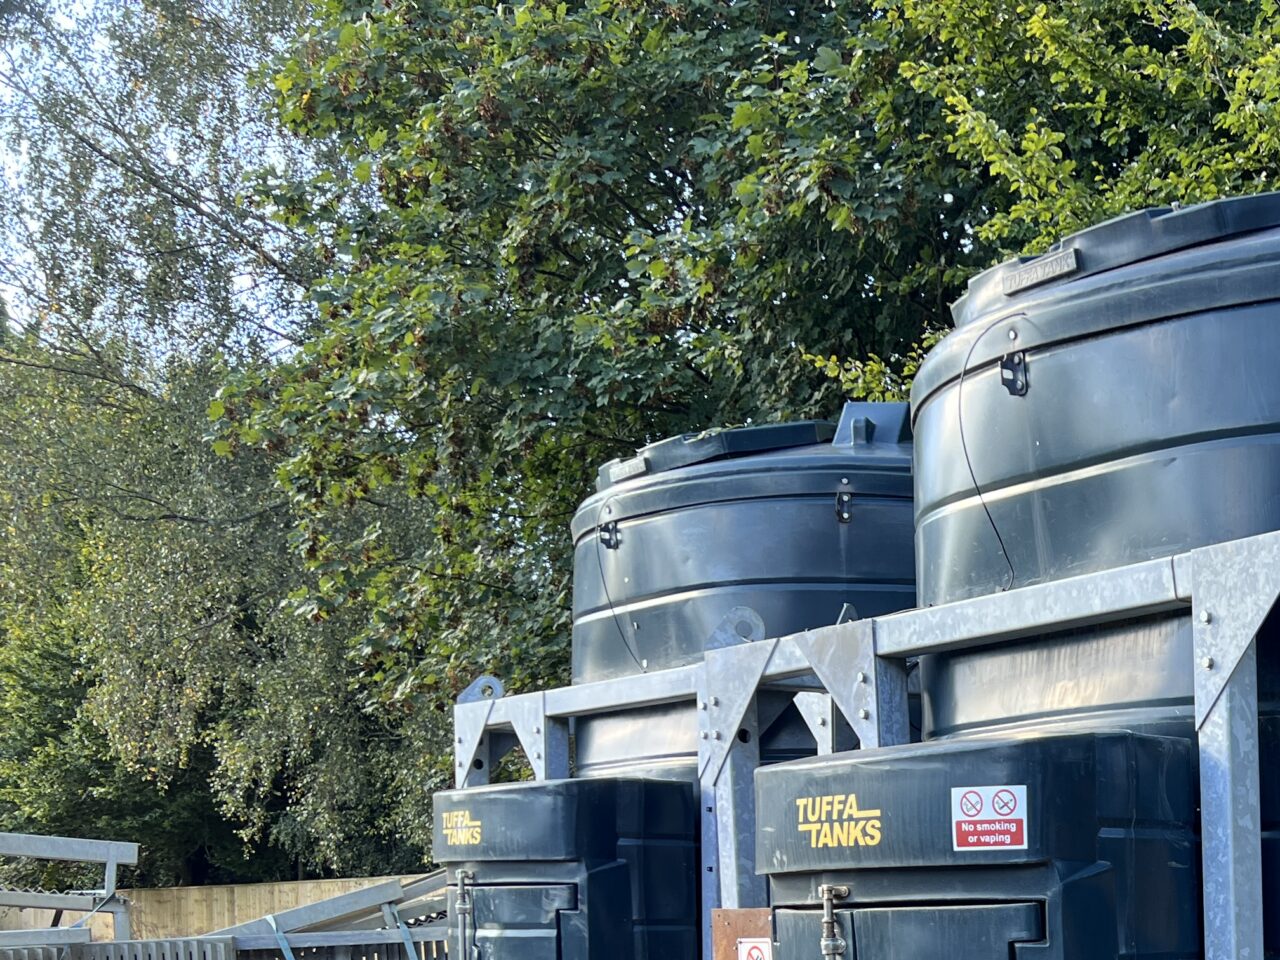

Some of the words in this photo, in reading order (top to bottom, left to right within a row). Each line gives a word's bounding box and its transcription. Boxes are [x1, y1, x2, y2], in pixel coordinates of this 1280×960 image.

[796, 793, 880, 823] TUFFA
[442, 810, 481, 829] TUFFA
[961, 822, 975, 832] No
[976, 821, 1016, 832] smoking
[443, 827, 481, 845] TANKS
[798, 819, 881, 848] TANKS
[968, 835, 978, 843] or
[980, 833, 1011, 844] vaping
